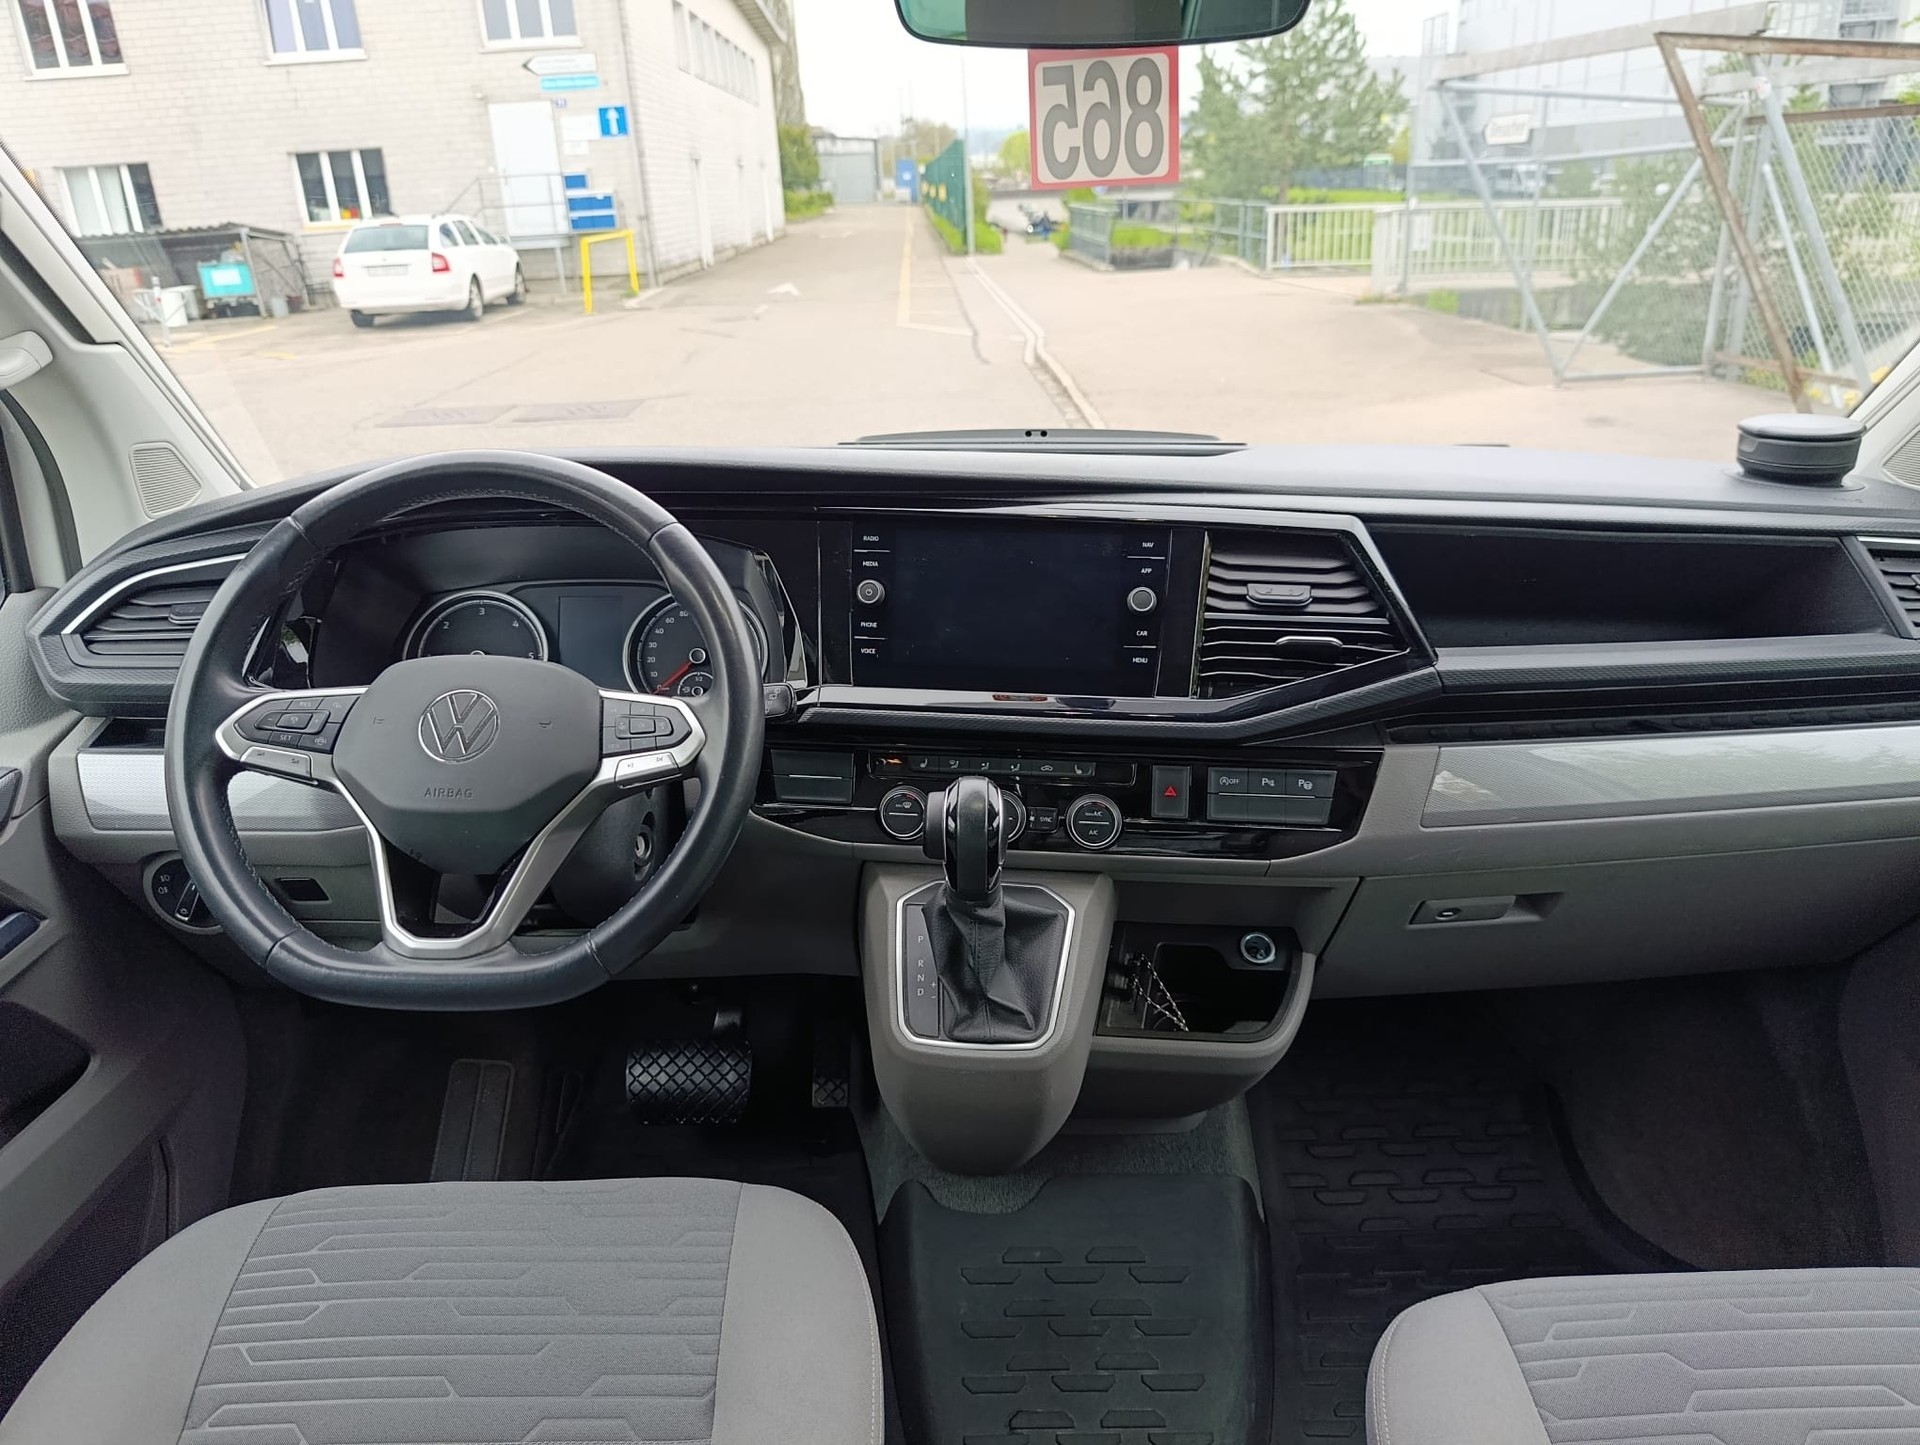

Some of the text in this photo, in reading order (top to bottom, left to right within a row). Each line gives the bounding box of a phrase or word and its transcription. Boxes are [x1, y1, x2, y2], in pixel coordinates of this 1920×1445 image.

[478, 607, 486, 616] 3
[443, 621, 450, 630] 2
[512, 620, 520, 628] 4
[654, 627, 665, 635] 40
[860, 647, 876, 655] VOICE
[279, 734, 293, 742] SET
[424, 787, 473, 799] AIRBAG
[917, 935, 924, 944] P
[917, 959, 924, 968] R
[917, 974, 925, 982] N
[917, 988, 925, 996] D
